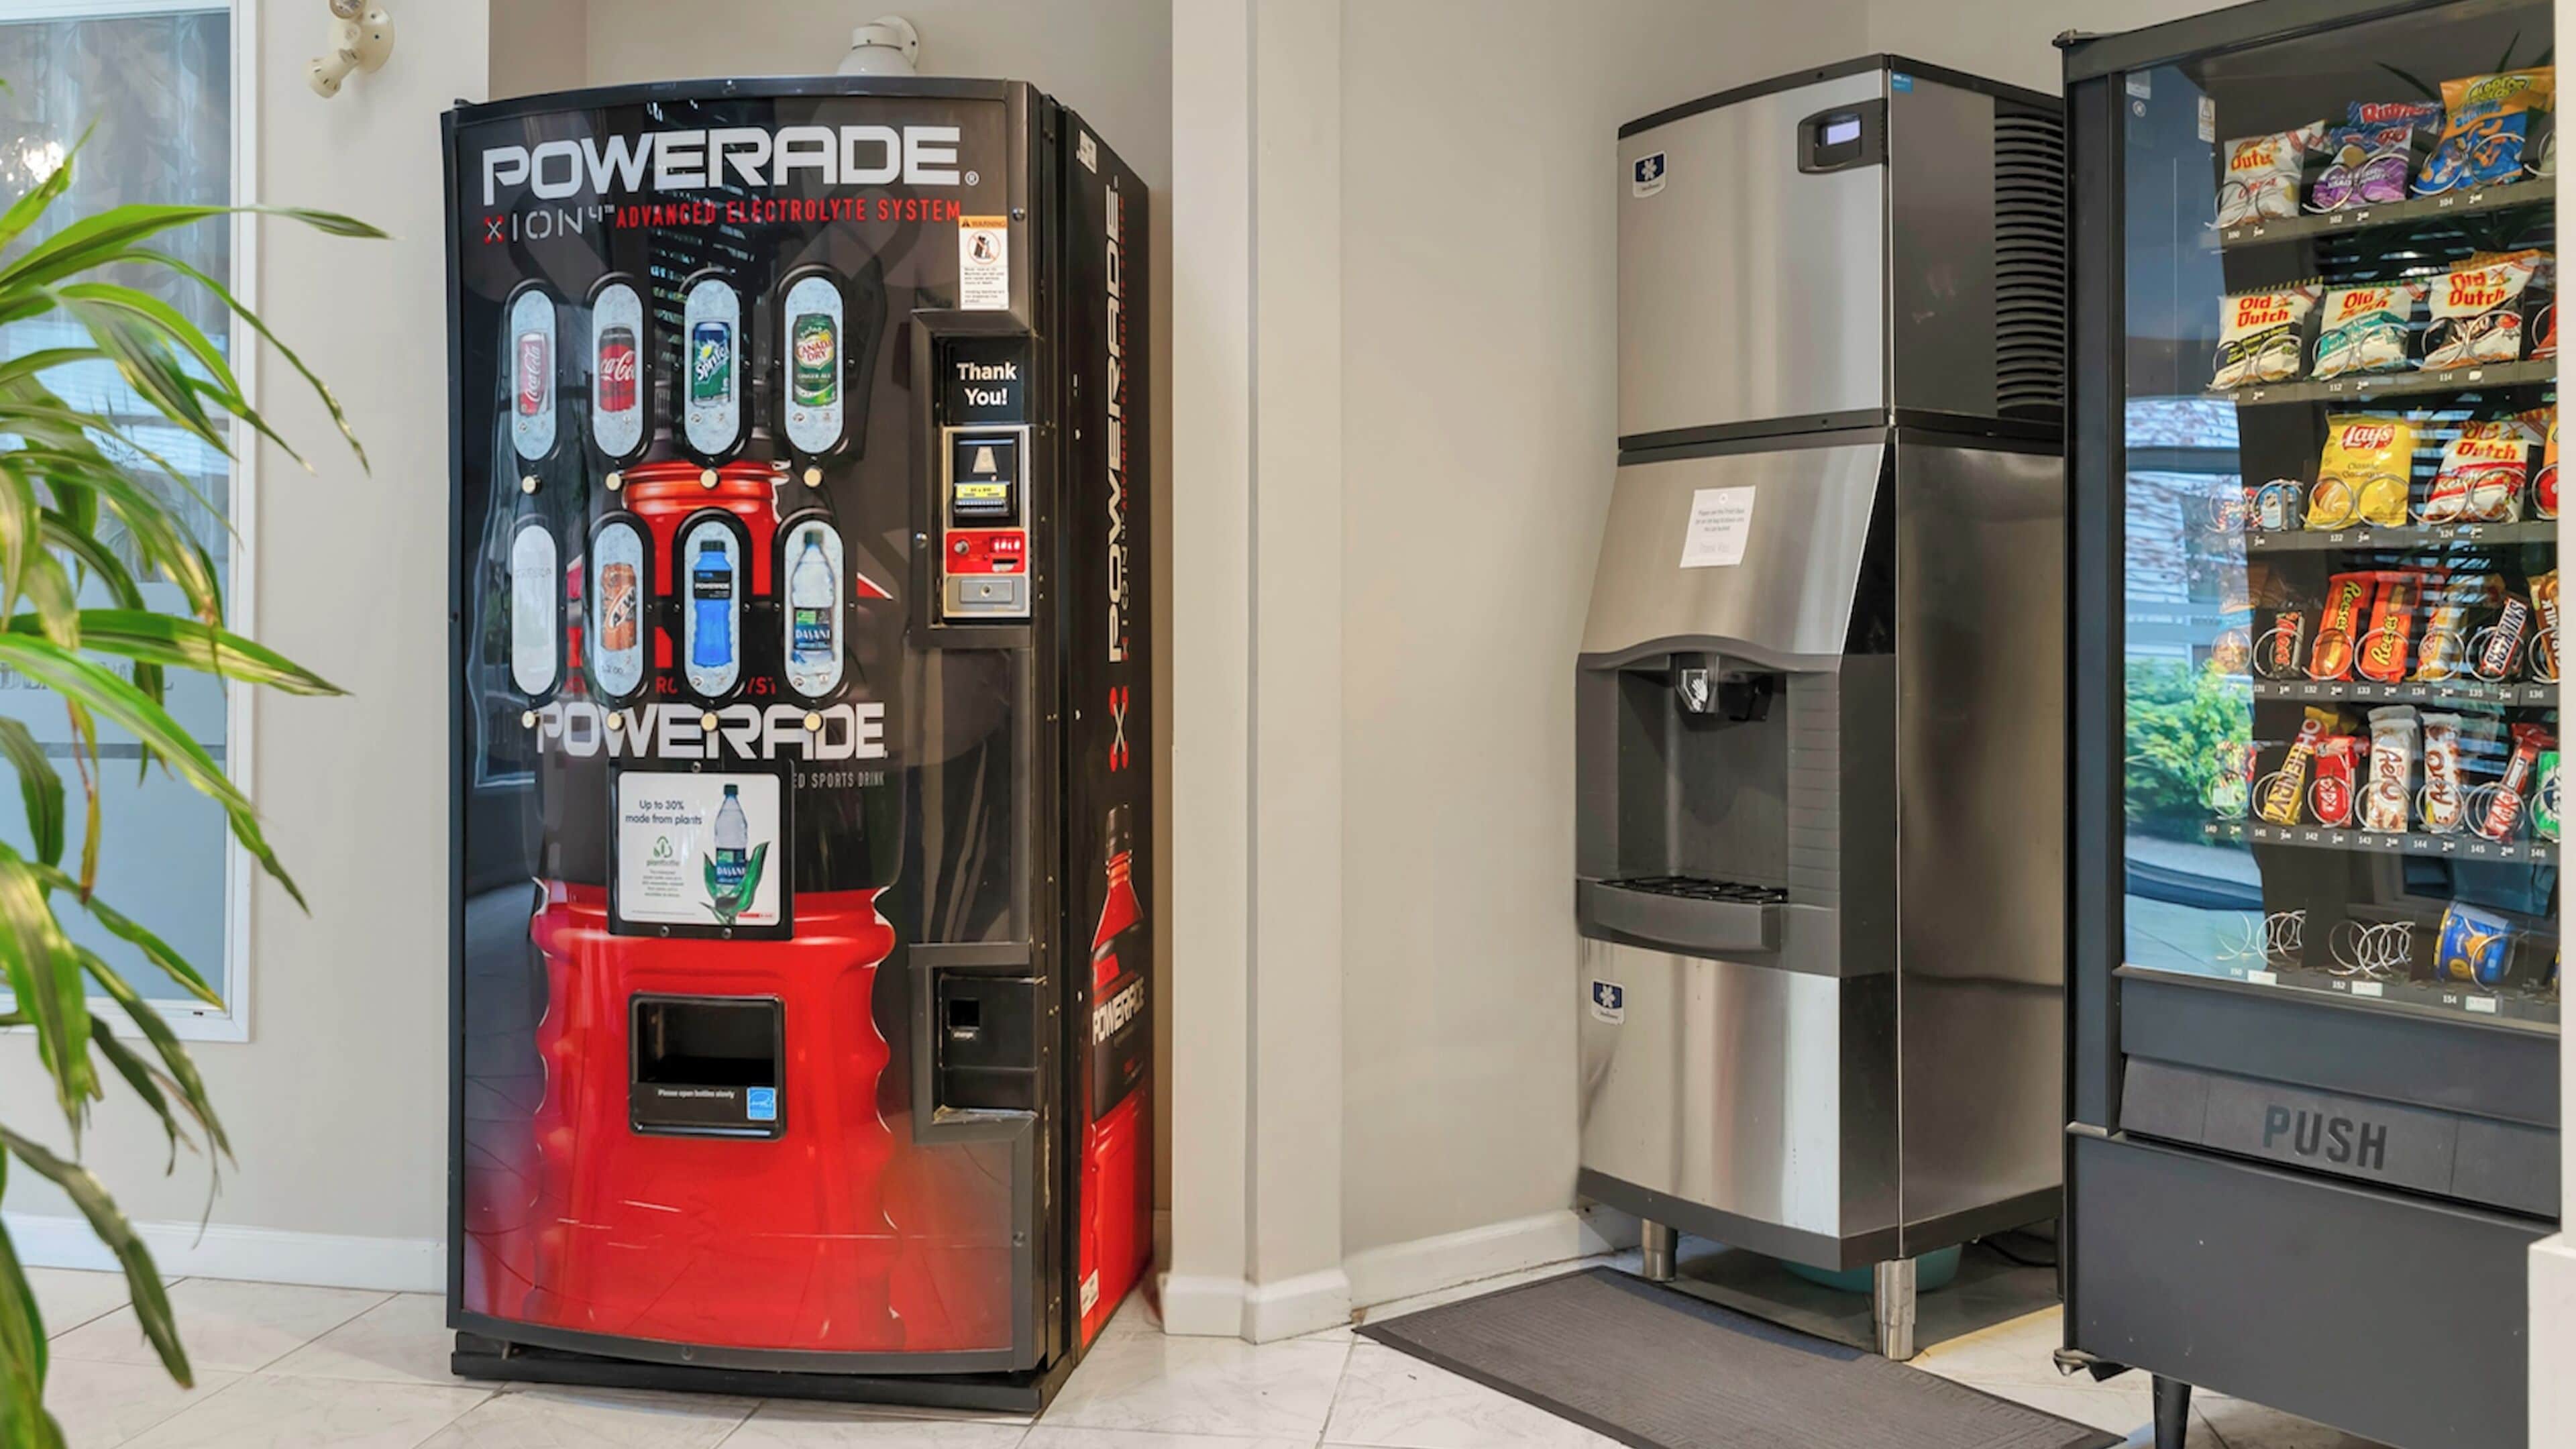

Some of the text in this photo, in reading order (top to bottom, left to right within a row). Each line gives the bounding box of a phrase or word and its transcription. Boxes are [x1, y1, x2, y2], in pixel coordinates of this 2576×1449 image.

[482, 125, 961, 205] POWERADE
[616, 201, 717, 229] ADVANCED
[727, 199, 867, 223] ELECTROLYTE
[877, 199, 961, 221] SYSTEM
[2449, 272, 2487, 290] Old
[2239, 296, 2273, 311] Old
[2343, 290, 2375, 309] Old
[2449, 288, 2506, 306] Dutch
[2237, 310, 2289, 328] Dutch
[956, 362, 1017, 381] Thank
[964, 388, 1008, 406] You!
[1106, 183, 1122, 663] POWERADE
[2457, 441, 2517, 460] Dutch
[537, 701, 885, 761] POWERADE
[811, 772, 854, 788] SPORTS
[639, 800, 652, 811] Up
[654, 800, 663, 810] to
[625, 814, 702, 826] made from plants
[2263, 1105, 2387, 1171] PUSH
